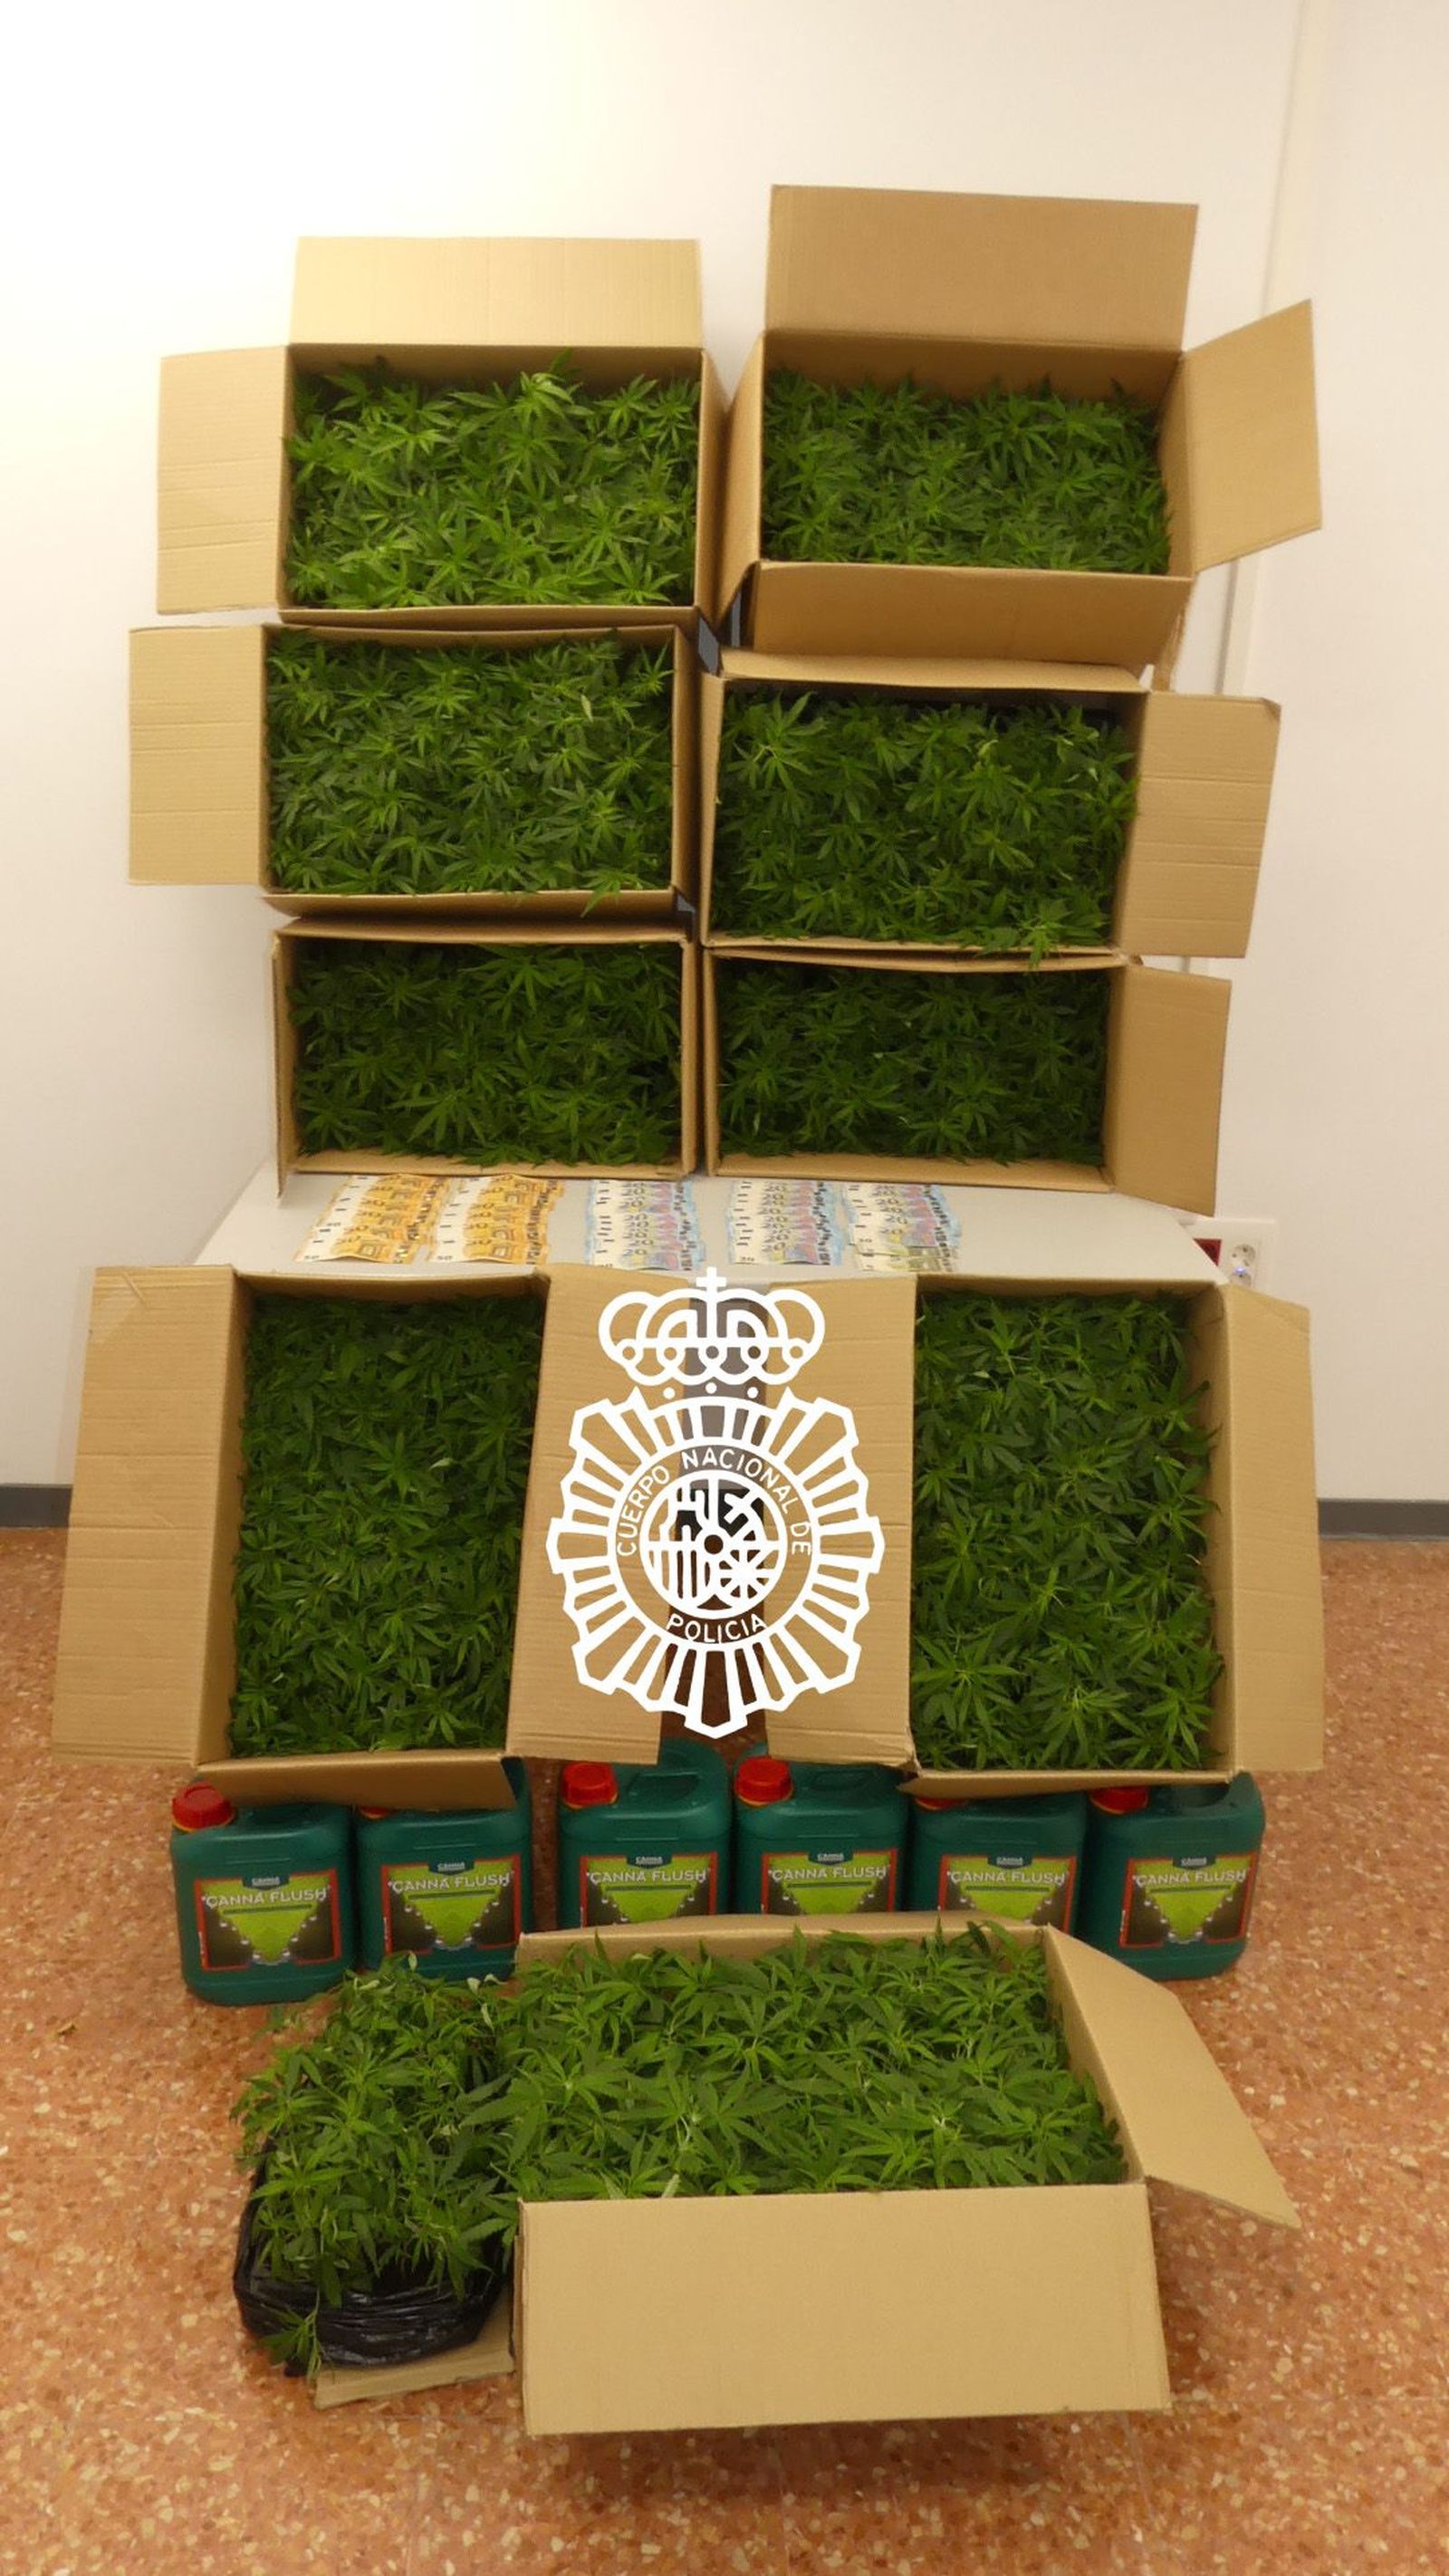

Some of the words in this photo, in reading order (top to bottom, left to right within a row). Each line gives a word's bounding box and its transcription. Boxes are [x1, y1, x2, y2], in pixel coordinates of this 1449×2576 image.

[590, 1871, 647, 1886] CANNA
[652, 1870, 706, 1884] FLUSH
[772, 1868, 828, 1882] CANNA
[832, 1866, 887, 1879] FLUSH
[951, 1870, 1006, 1884] CANNA
[1012, 1871, 1065, 1886] FLUSH
[1136, 1873, 1189, 1888] CANNA
[1195, 1869, 1247, 1883] FLUSH
[392, 1878, 450, 1894] CANNA
[454, 1872, 511, 1888] FLUSH
[206, 1893, 264, 1909] CANNA
[271, 1889, 327, 1902] FLUSH
